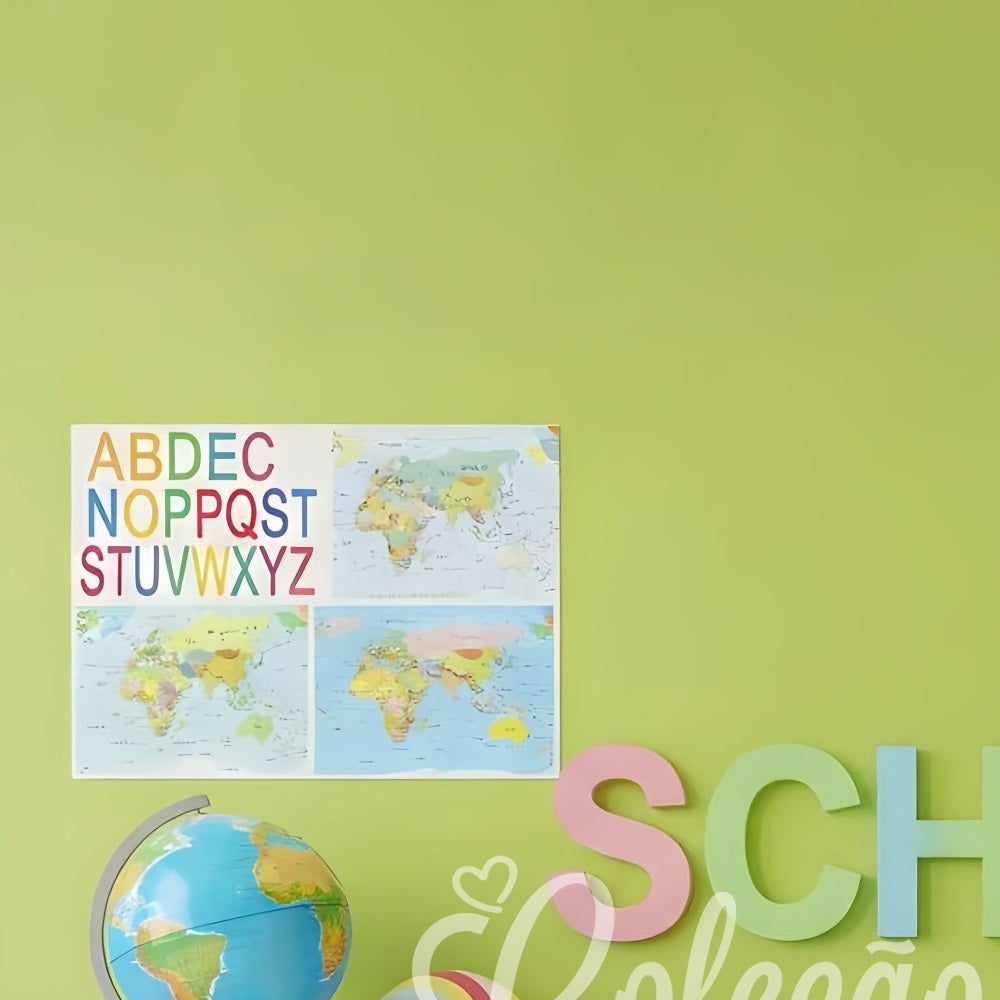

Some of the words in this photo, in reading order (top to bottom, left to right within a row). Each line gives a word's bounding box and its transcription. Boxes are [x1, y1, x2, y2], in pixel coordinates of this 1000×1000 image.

[87, 431, 275, 481] ABDEC
[88, 487, 317, 540] NOPPQST
[80, 545, 316, 597] STUVWXYZ
